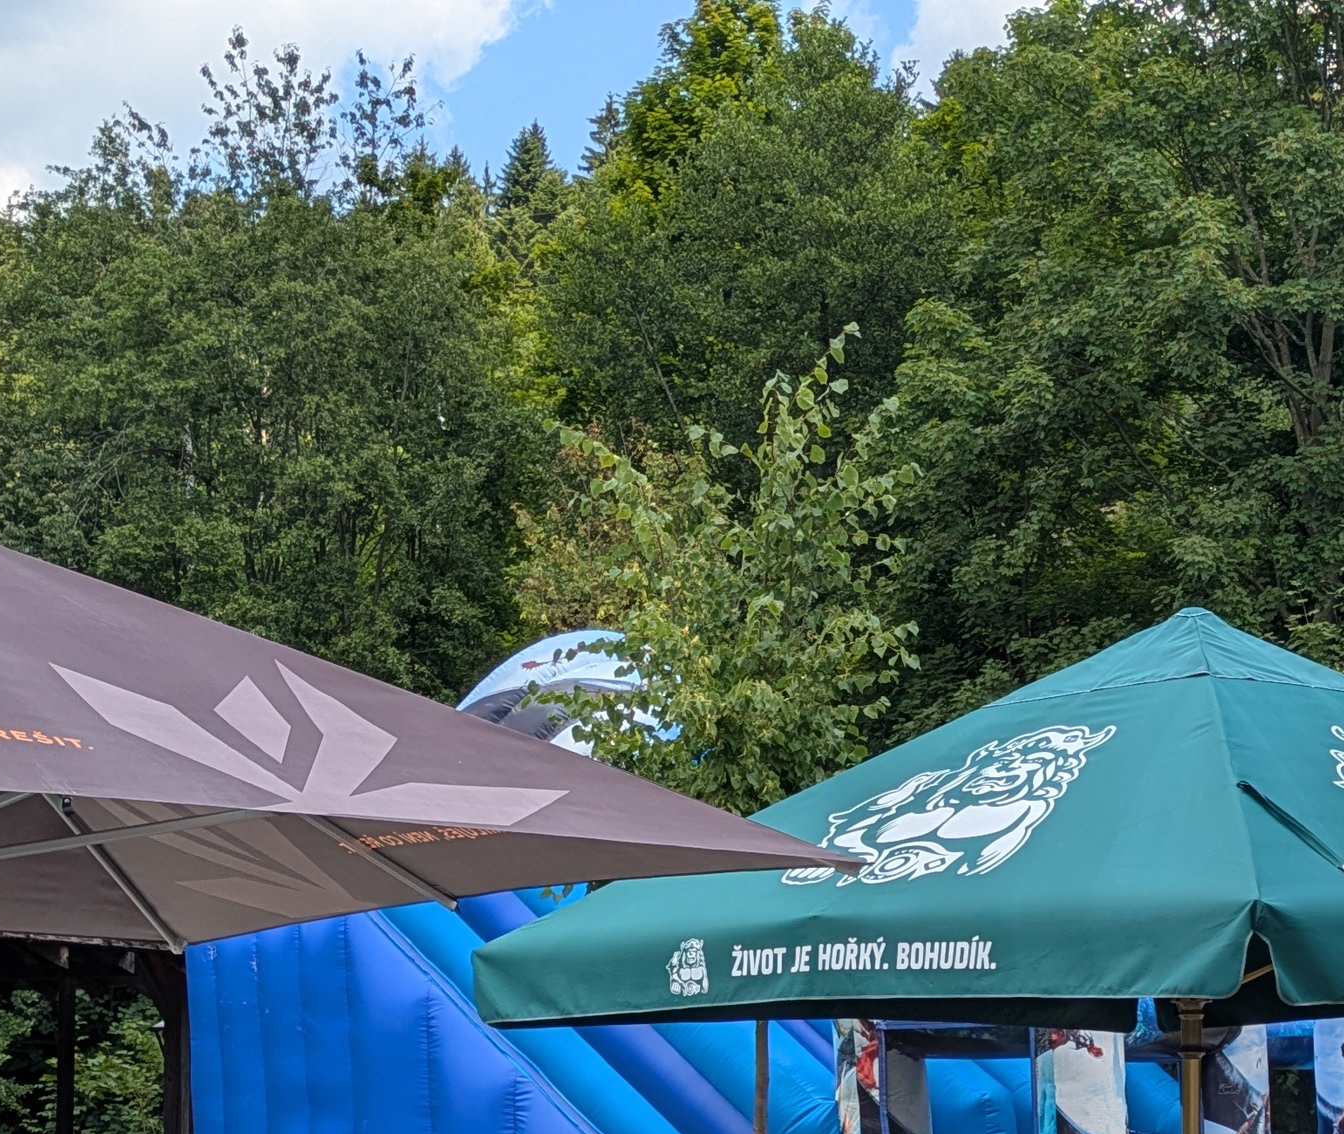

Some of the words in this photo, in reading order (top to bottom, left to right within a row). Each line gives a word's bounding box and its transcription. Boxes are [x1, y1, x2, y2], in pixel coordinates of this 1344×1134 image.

[731, 944, 786, 977] ŽIVOT
[790, 945, 812, 973] JE
[818, 936, 889, 971] HOŘKÝ.
[896, 935, 997, 970] BOHUDÍK.
